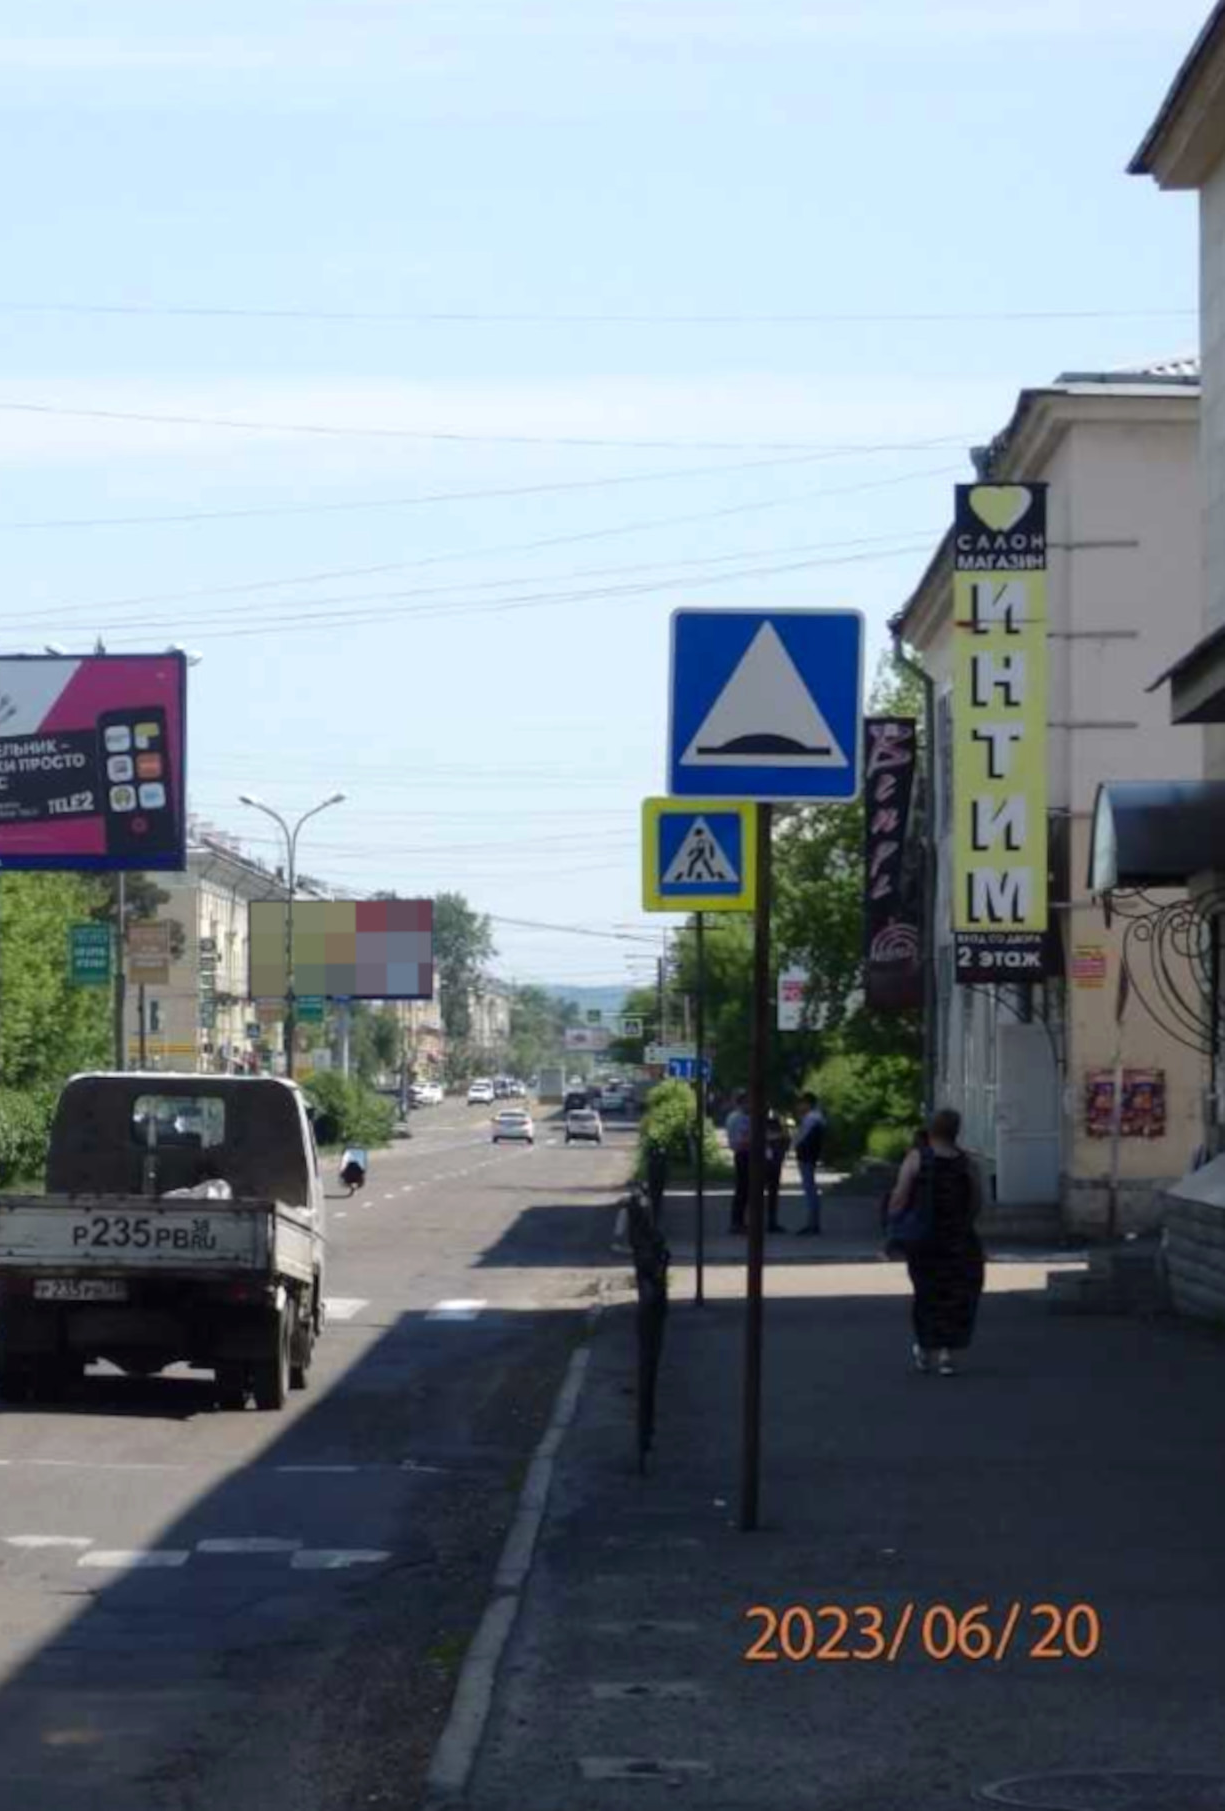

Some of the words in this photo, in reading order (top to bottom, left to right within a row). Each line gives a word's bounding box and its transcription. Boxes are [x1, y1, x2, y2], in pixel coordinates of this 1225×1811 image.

[956, 533, 1044, 551] САЛОН
[956, 554, 1044, 570] МАГАЗИН
[19, 752, 86, 773] ПРОСТО
[969, 581, 1033, 924] ИНТИМ
[47, 790, 95, 815] TELE2
[957, 945, 972, 968] 2
[978, 950, 1042, 968] этаж
[191, 1234, 217, 1250] RU
